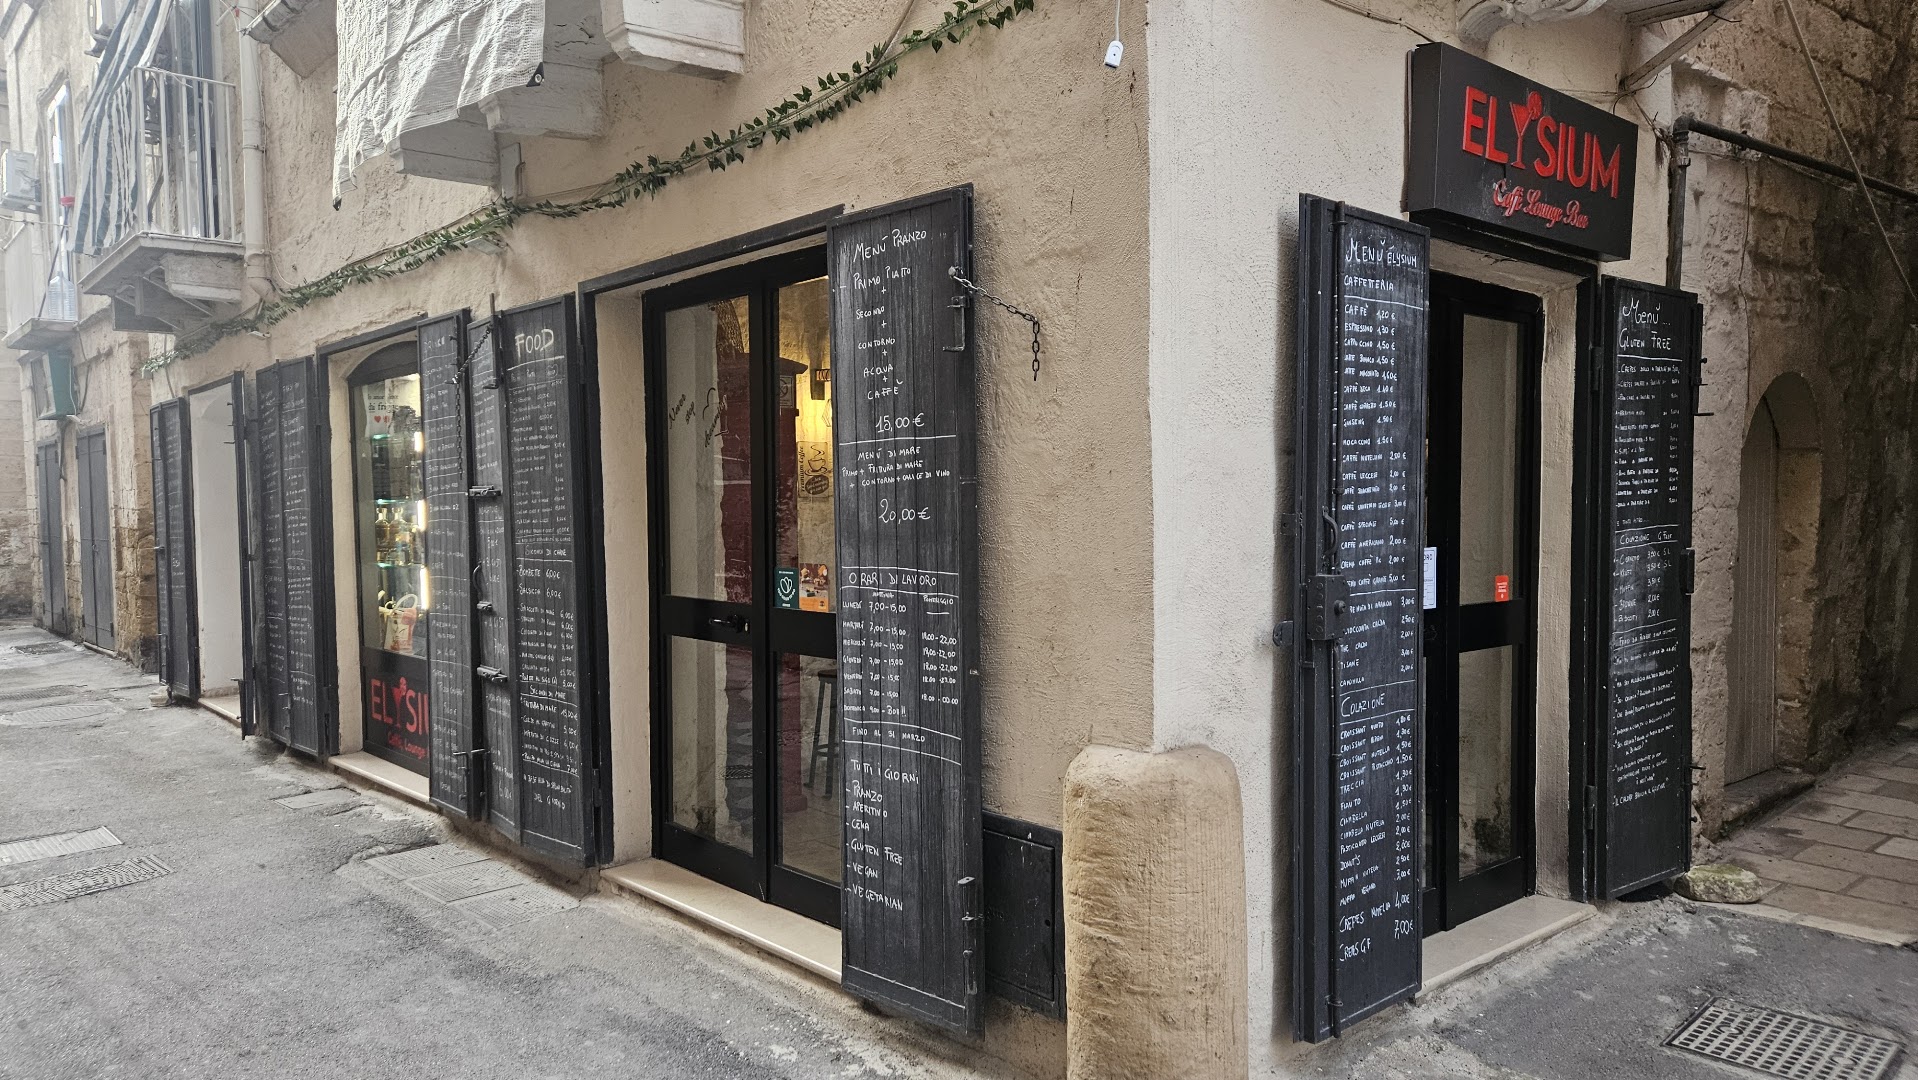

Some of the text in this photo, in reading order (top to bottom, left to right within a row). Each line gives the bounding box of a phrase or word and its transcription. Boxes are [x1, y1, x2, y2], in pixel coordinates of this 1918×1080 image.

[1462, 85, 1620, 199] ELYSIUM
[1523, 189, 1563, 228] Lounge
[1562, 200, 1589, 228] Bar
[892, 228, 927, 247] PRANZO
[853, 272, 880, 290] PRIMO
[856, 305, 885, 319] SECONDO
[515, 329, 554, 357] FOOD
[858, 338, 895, 350] CONTORNO
[888, 450, 896, 458] DI
[900, 447, 920, 456] MARE
[862, 477, 894, 486] CONTORNO
[849, 572, 936, 586] ORARI DI LAVORO
[1341, 693, 1385, 717] COLAZIONE
[852, 727, 868, 736] FINO
[902, 734, 925, 742] MARZO
[852, 780, 882, 802] PRANZO
[852, 803, 887, 818] APERITIVO
[851, 818, 870, 831] CENA
[850, 839, 903, 866] GLUTEN FREE
[852, 862, 878, 879] VEGAN
[852, 883, 903, 911] VEGETARIAN
